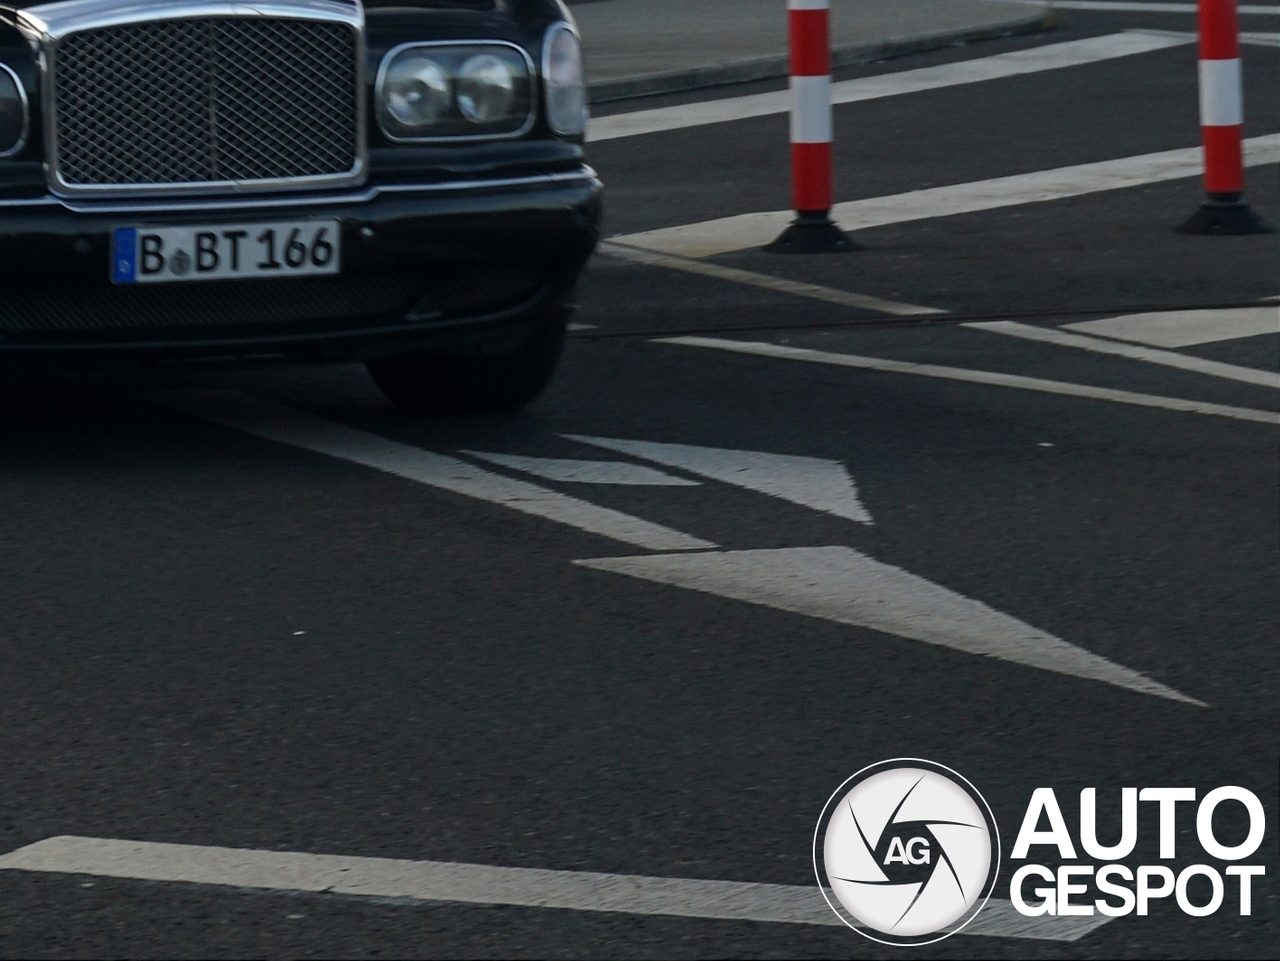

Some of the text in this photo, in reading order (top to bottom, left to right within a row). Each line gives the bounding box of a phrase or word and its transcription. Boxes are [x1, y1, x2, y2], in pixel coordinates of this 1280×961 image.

[139, 226, 334, 275] B BT 166
